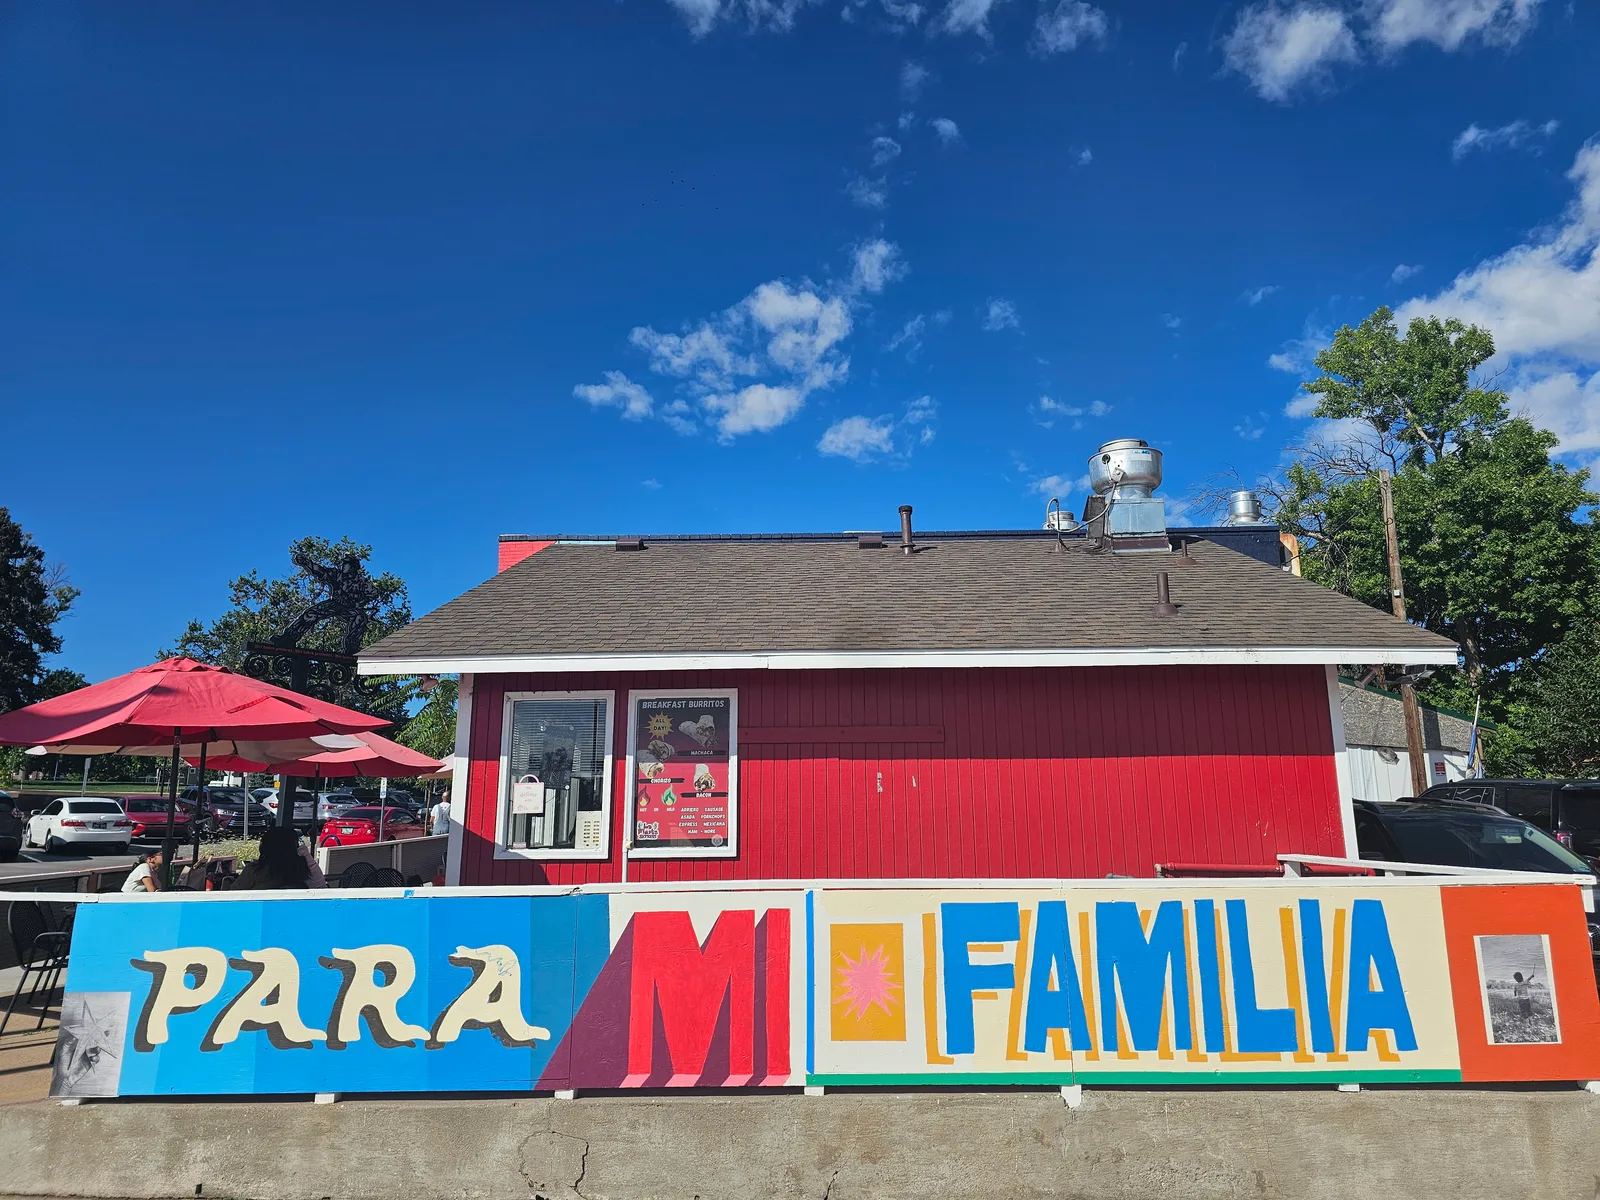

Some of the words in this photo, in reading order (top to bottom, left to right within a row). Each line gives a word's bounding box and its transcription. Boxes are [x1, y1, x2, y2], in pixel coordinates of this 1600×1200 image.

[642, 701, 686, 709] BREAKFAST
[688, 700, 725, 708] BURRITOS
[130, 944, 551, 1052] PARA
[619, 908, 792, 1087] MI
[924, 899, 1419, 1062] FAMILIA
